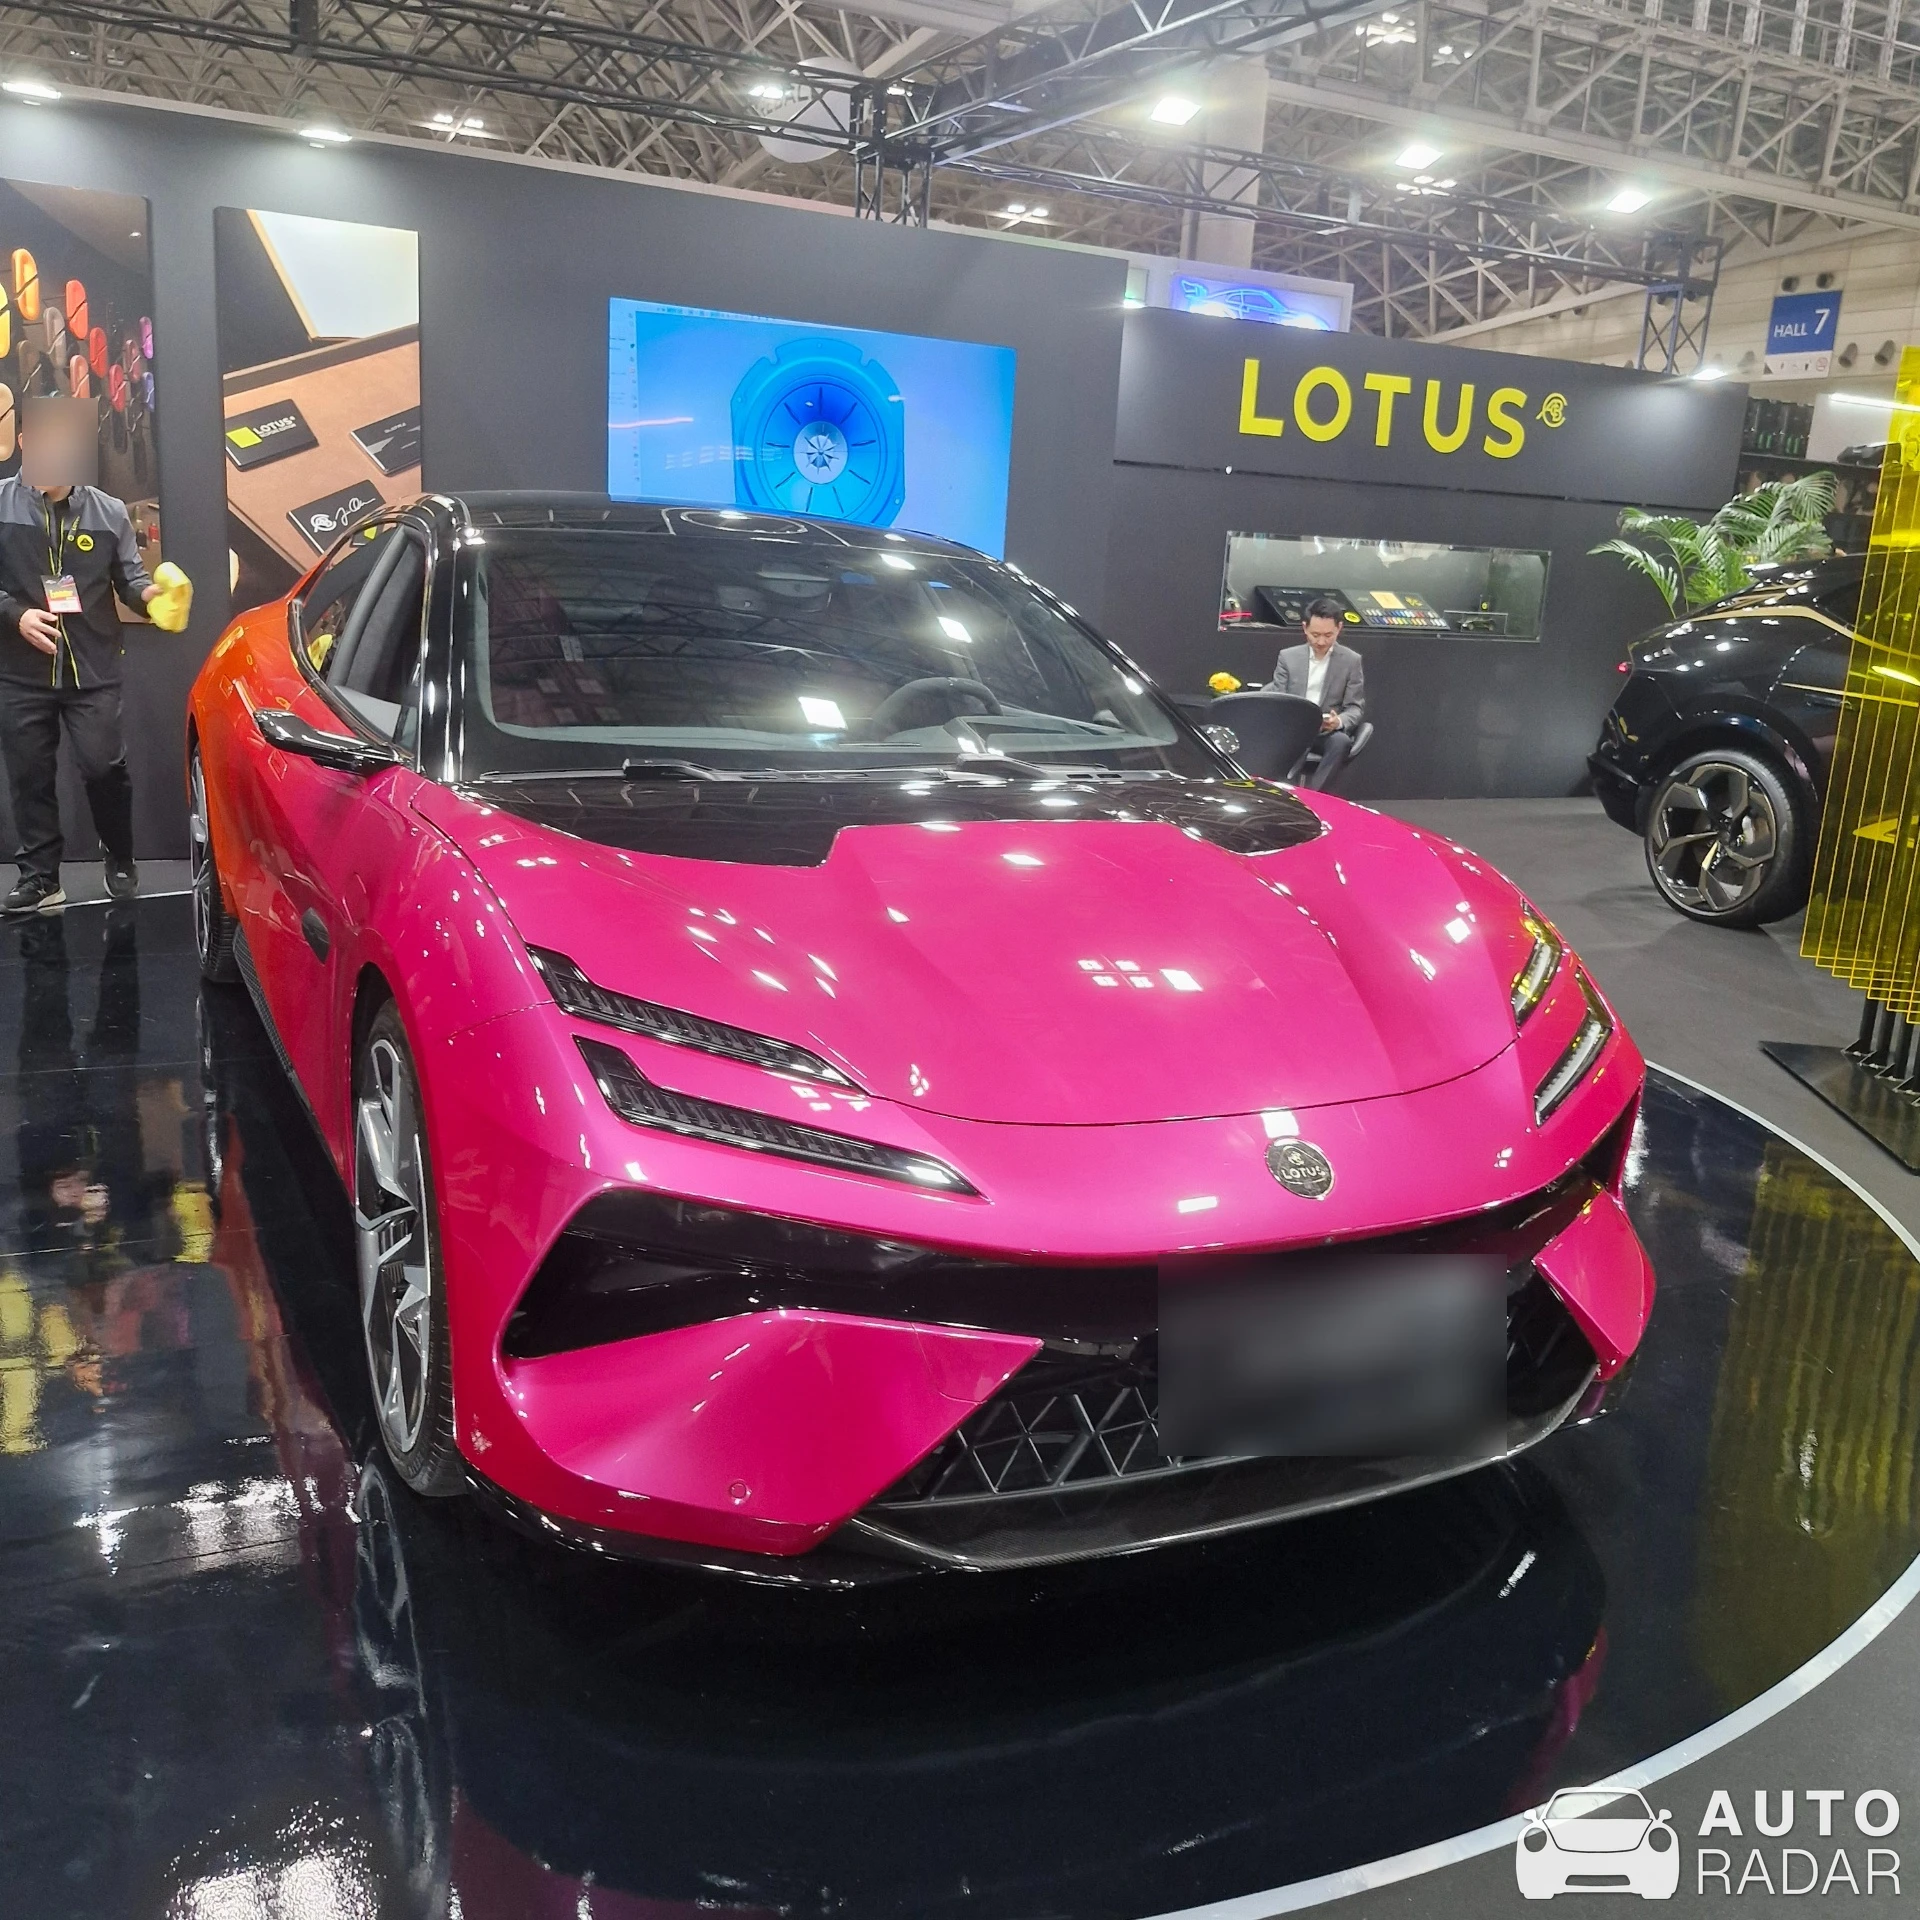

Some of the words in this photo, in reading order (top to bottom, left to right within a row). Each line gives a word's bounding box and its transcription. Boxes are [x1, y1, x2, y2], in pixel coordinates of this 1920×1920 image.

[1774, 323, 1808, 337] HALL
[1814, 308, 1830, 335] 7
[1239, 358, 1528, 459] LOTUS
[252, 417, 293, 435] LOTUS
[1281, 1165, 1326, 1180] LOTUS
